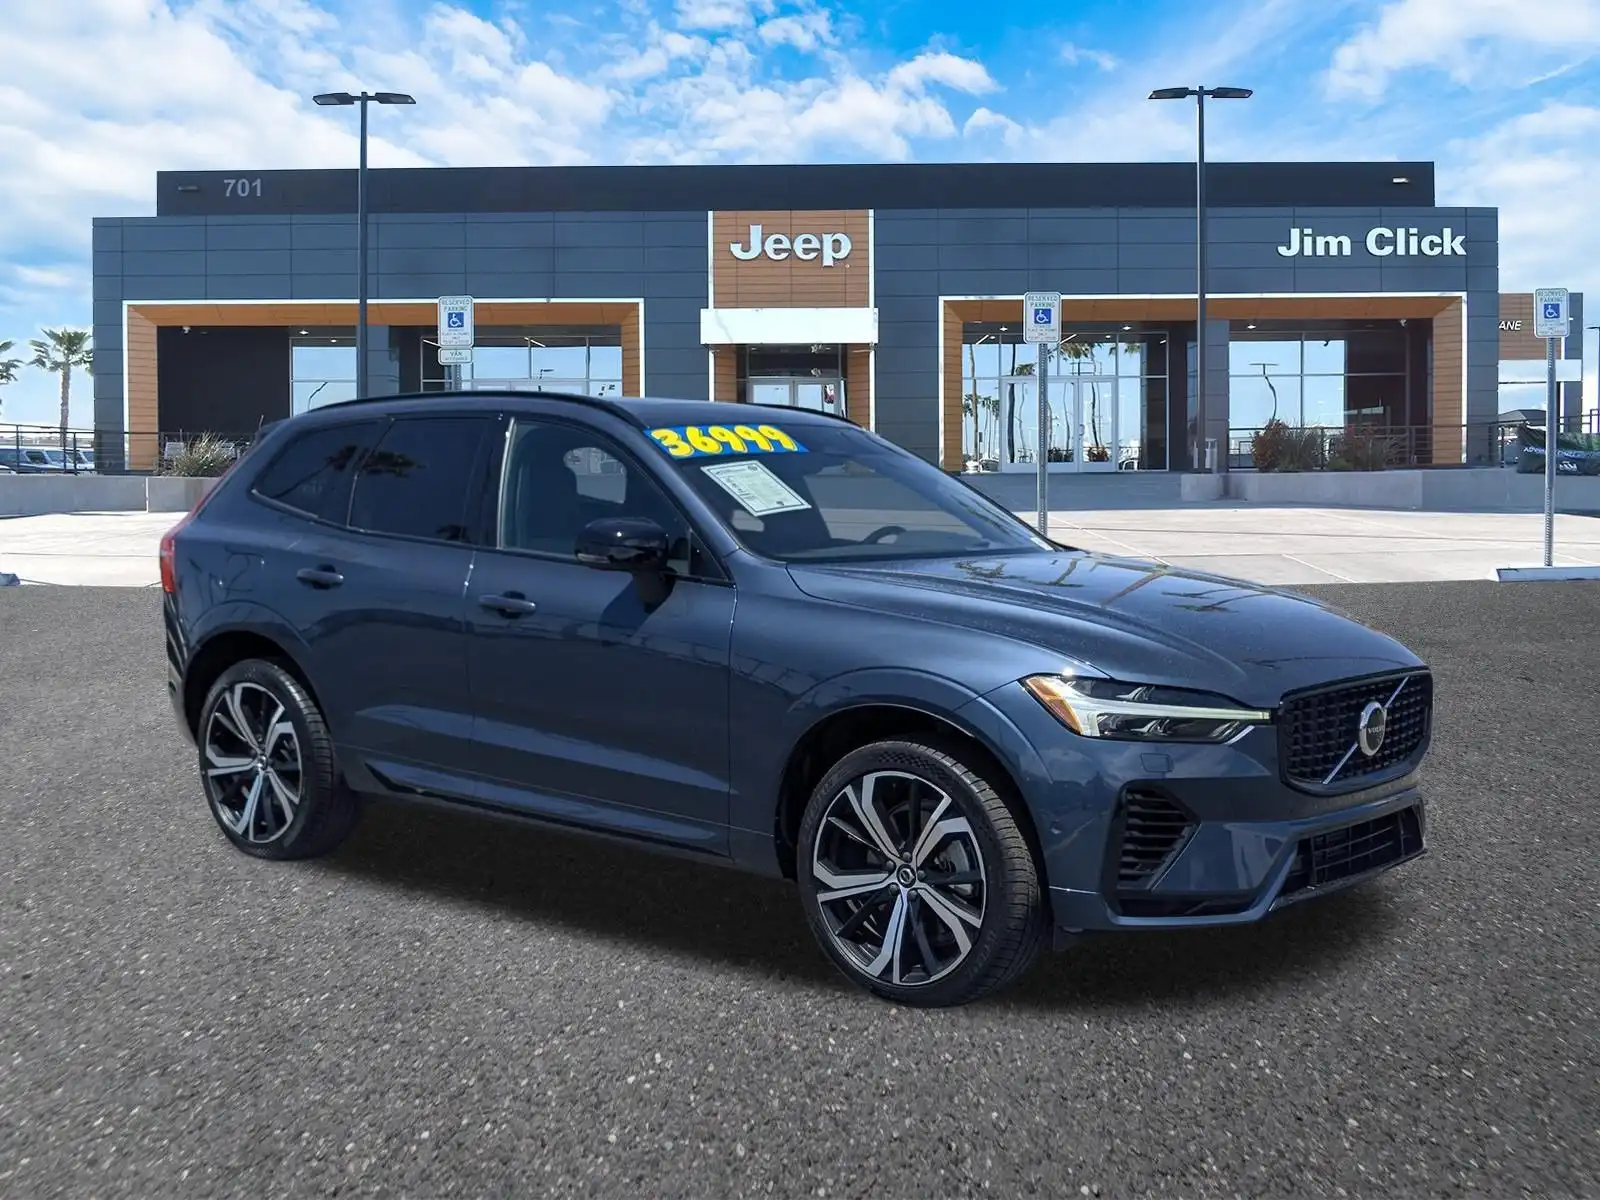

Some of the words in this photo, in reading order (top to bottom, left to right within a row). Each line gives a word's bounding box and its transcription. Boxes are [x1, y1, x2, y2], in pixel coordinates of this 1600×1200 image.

[223, 178, 261, 197] 701
[729, 223, 852, 267] Jeep
[1277, 227, 1352, 257] Jim
[1365, 227, 1467, 257] Click
[1498, 320, 1522, 330] ANE
[650, 424, 799, 457] 36999
